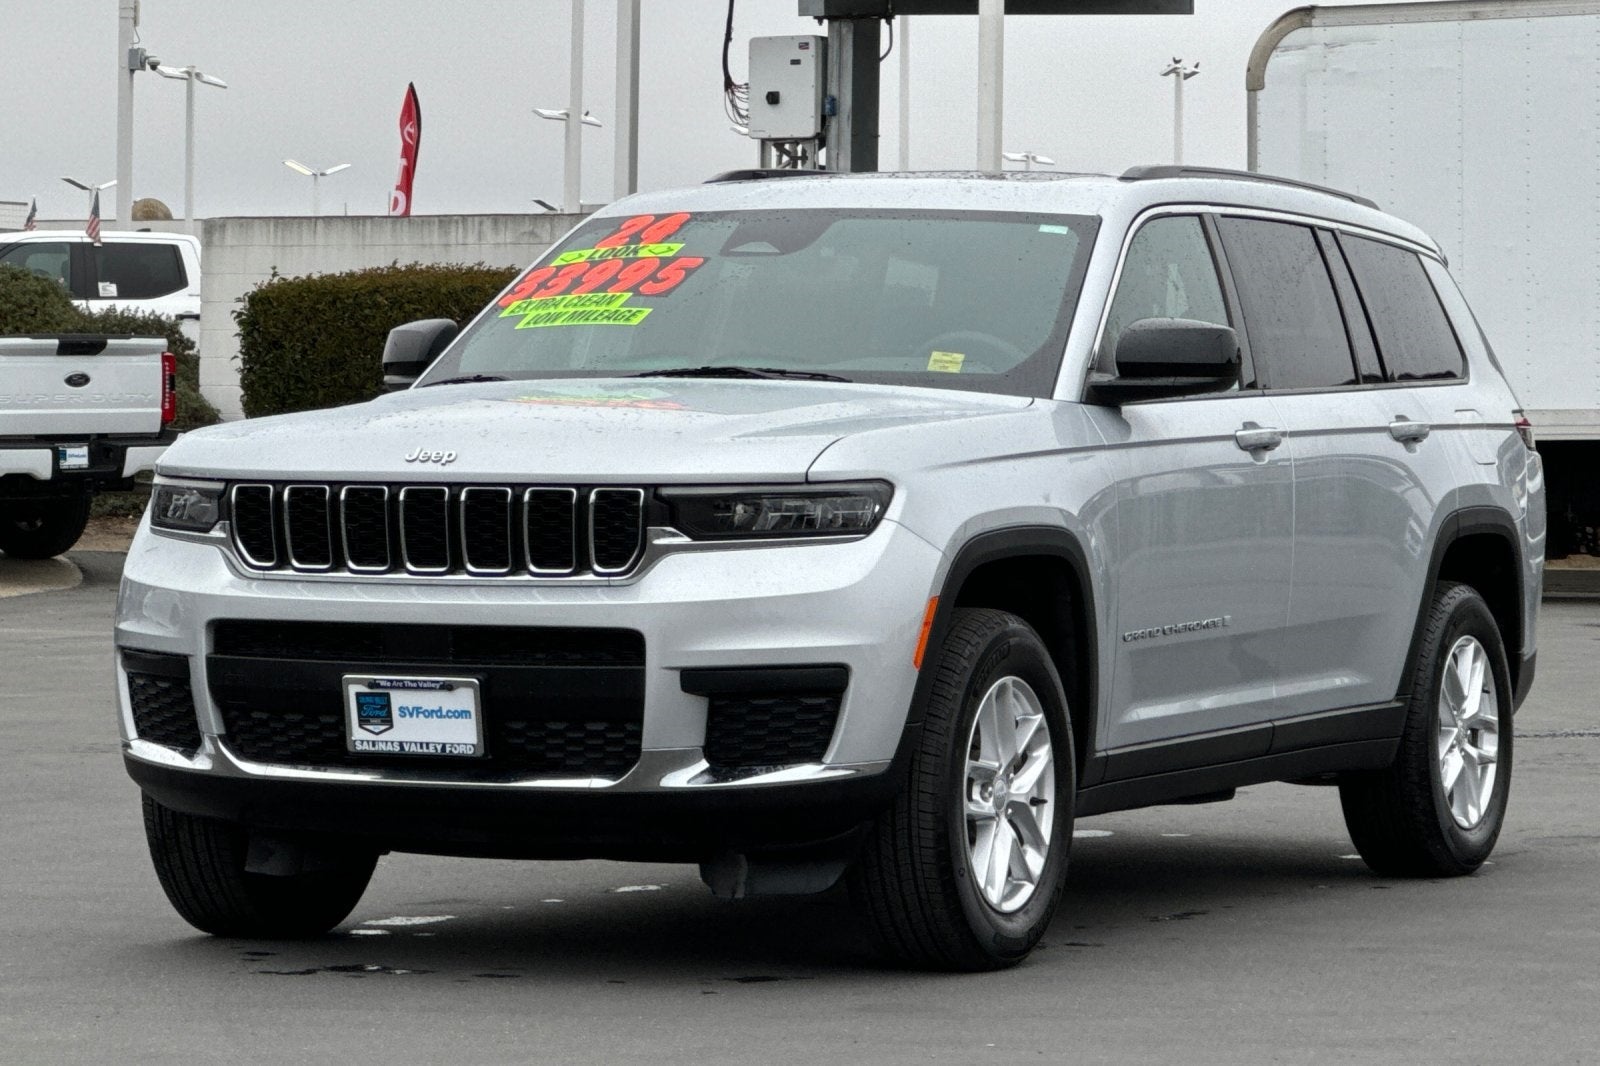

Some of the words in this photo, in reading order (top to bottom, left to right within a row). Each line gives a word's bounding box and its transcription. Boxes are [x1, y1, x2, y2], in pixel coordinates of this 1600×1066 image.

[498, 257, 704, 308] 33995
[512, 298, 563, 314] EXTRA
[564, 294, 623, 308] CLEAN
[523, 311, 566, 327] LOW
[561, 309, 643, 323] MILEAGE
[91, 392, 153, 403] DUTY
[405, 446, 457, 466] Jeep
[1122, 627, 1162, 642] GRAND
[398, 706, 472, 719] SVFord.com
[402, 742, 443, 753] VALLEY
[446, 744, 475, 755] FORD
